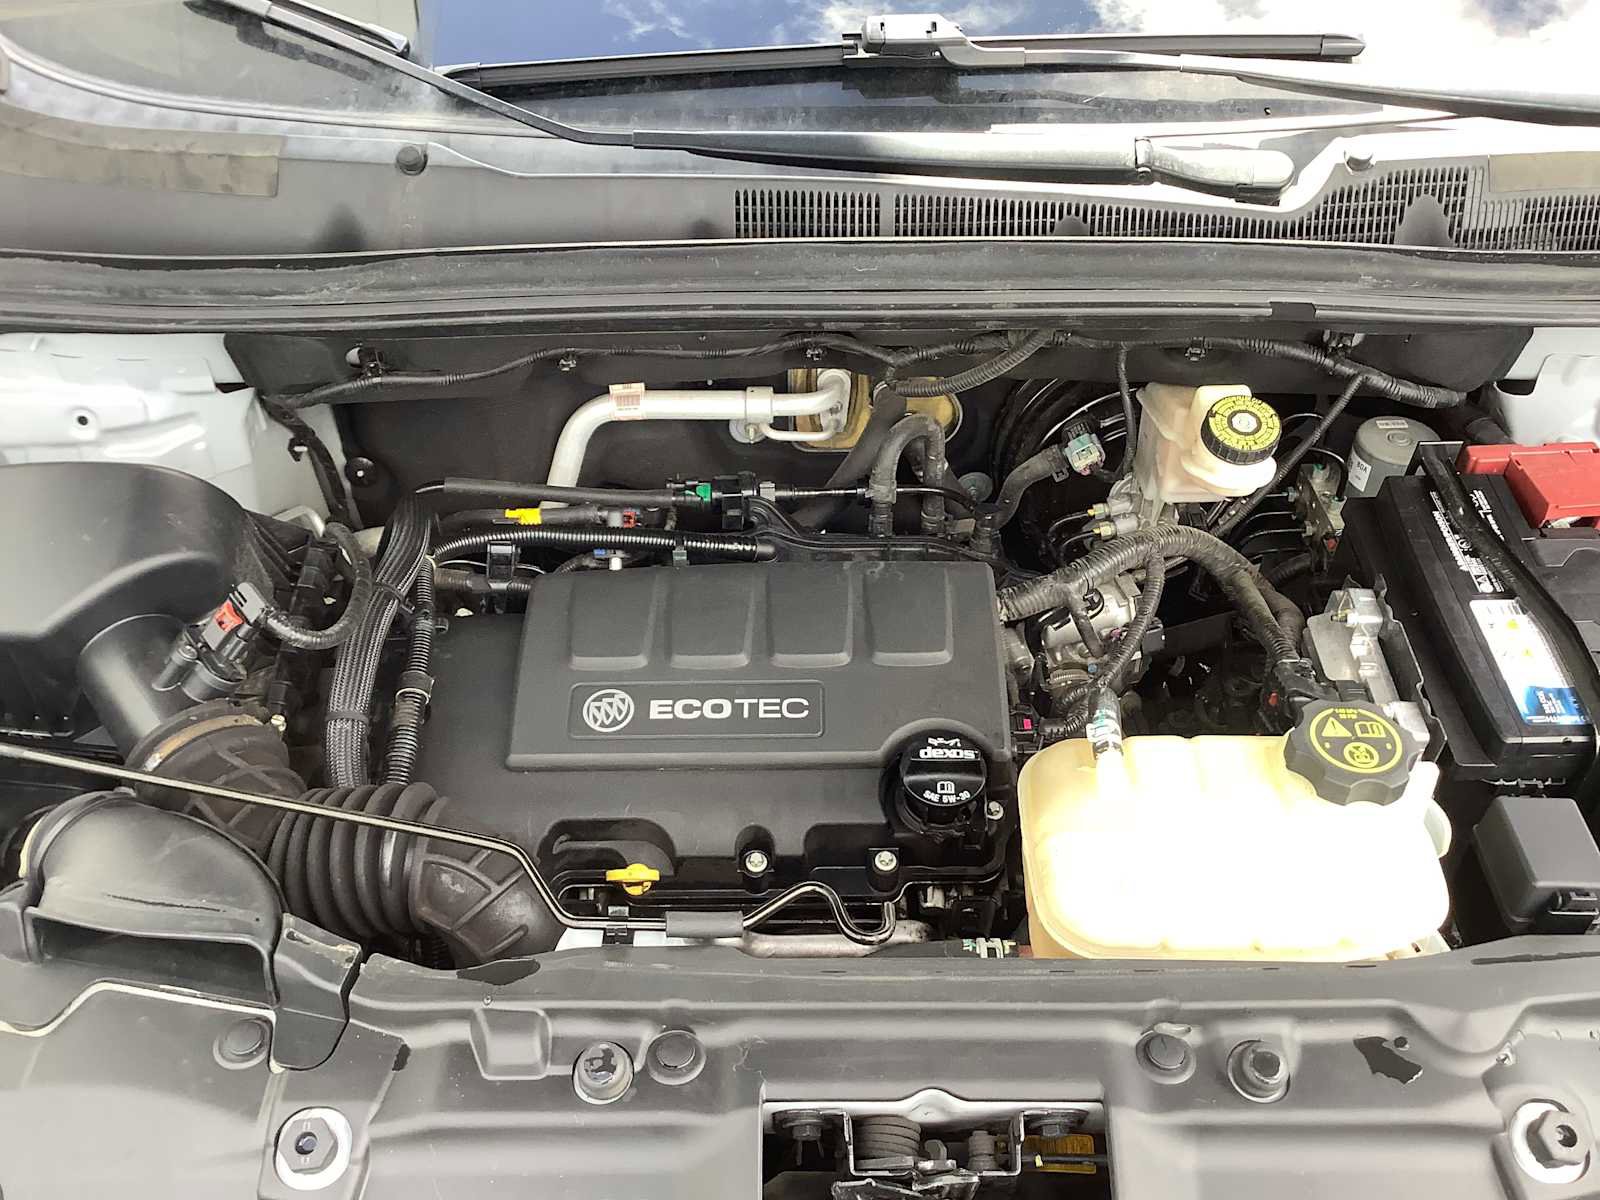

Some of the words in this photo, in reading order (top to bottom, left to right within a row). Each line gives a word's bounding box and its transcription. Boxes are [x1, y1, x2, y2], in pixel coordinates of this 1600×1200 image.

[649, 698, 809, 719] ECOTEC
[919, 746, 976, 759] dexos
[923, 790, 940, 803] SAE
[942, 790, 971, 804] 5W-30
